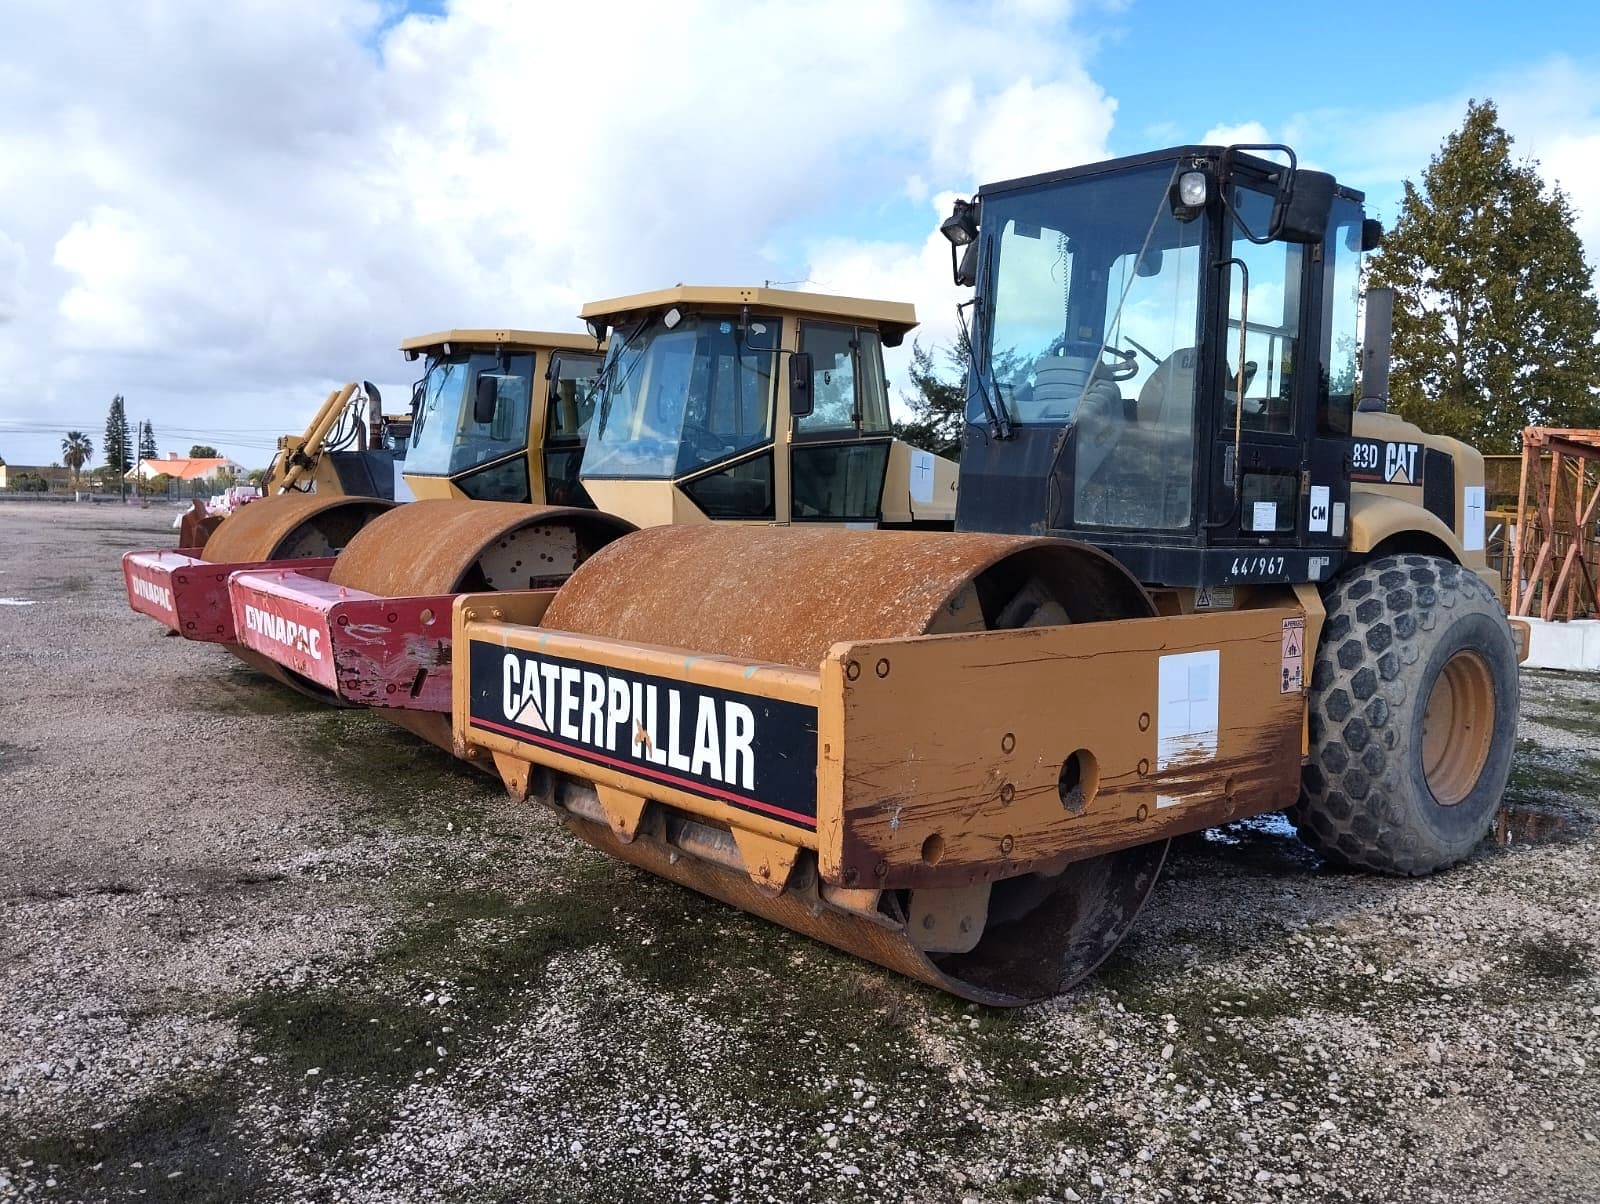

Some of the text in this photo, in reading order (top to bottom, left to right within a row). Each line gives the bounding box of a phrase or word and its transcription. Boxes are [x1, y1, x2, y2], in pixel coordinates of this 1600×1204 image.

[1384, 442, 1418, 484] CAT
[1311, 505, 1326, 521] CM
[1231, 556, 1284, 576] 44/967
[131, 575, 173, 612] DYNAPAC
[245, 603, 322, 660] DYNAPAC
[502, 653, 755, 791] CATERPILLAR
